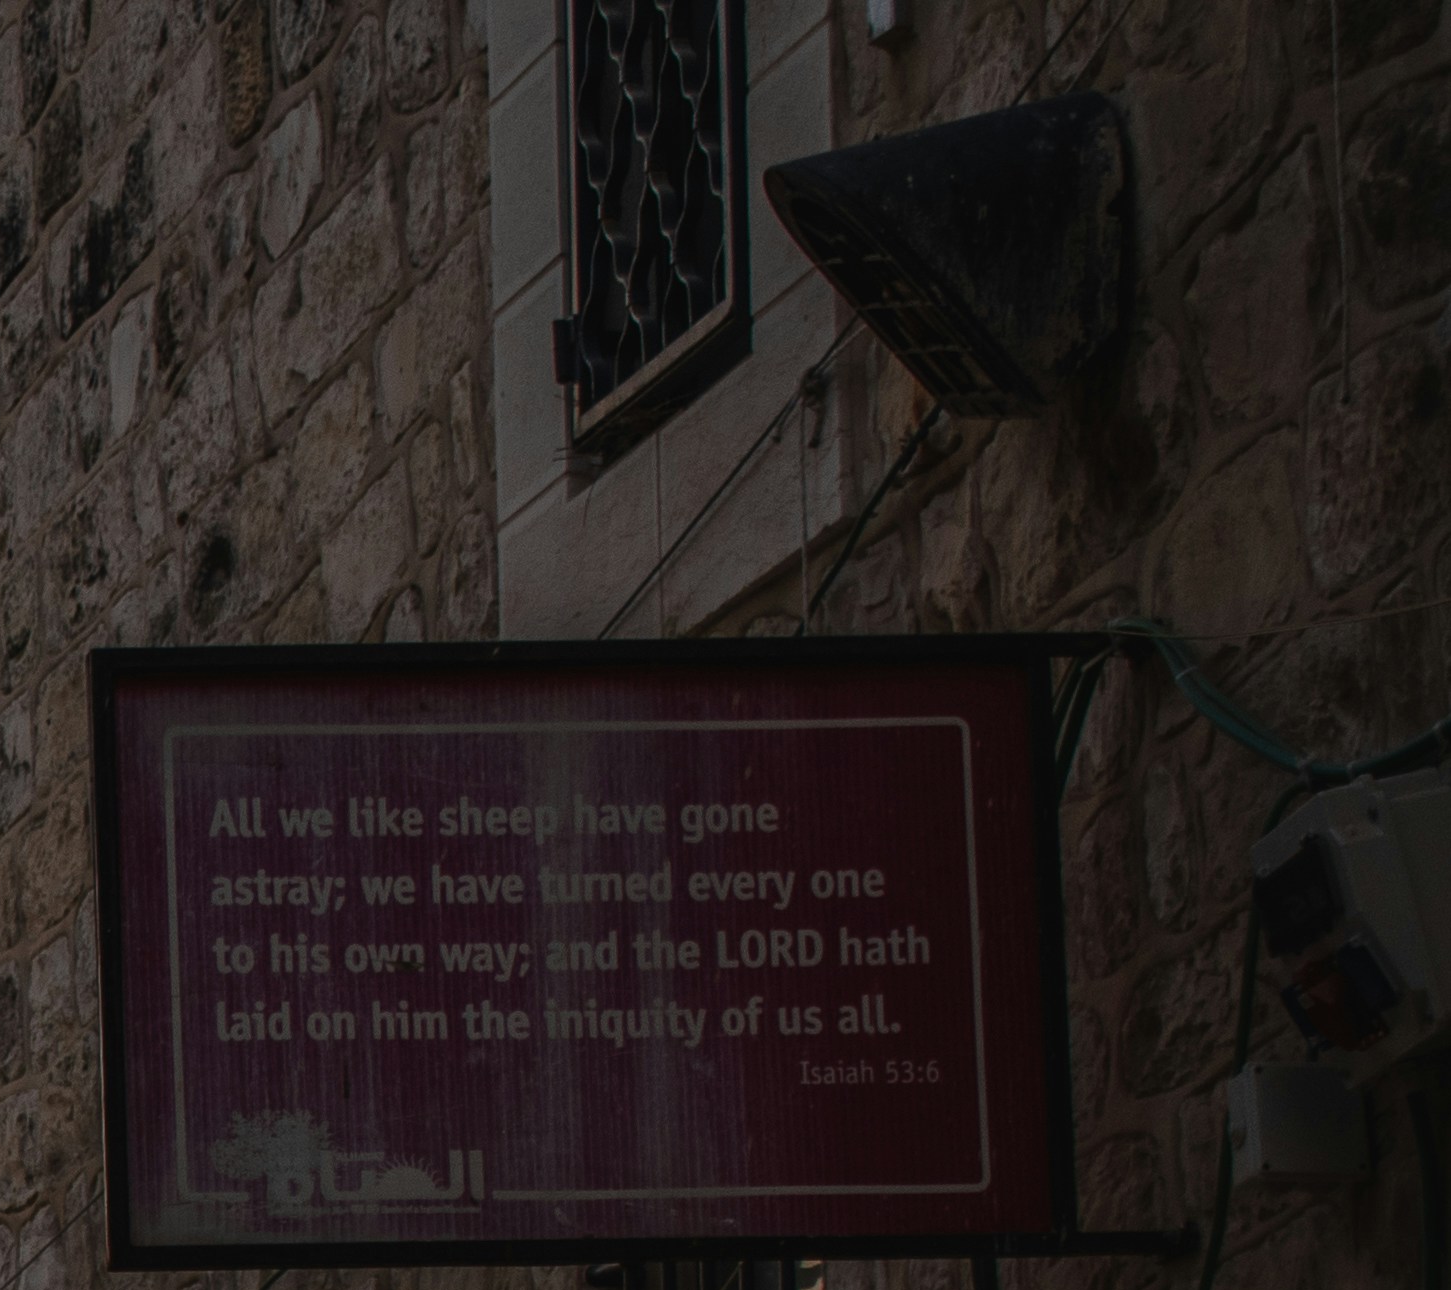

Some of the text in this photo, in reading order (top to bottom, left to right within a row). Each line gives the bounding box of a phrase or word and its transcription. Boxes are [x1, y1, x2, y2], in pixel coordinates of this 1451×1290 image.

[209, 794, 779, 846] All we like sheep have gone
[210, 861, 886, 915] astray; we have turned every one
[212, 925, 930, 983] to his own way; and the LORD hath
[216, 993, 901, 1048] laid on him the iniquity of us all.
[799, 1058, 940, 1087] Isaiah 53:6
